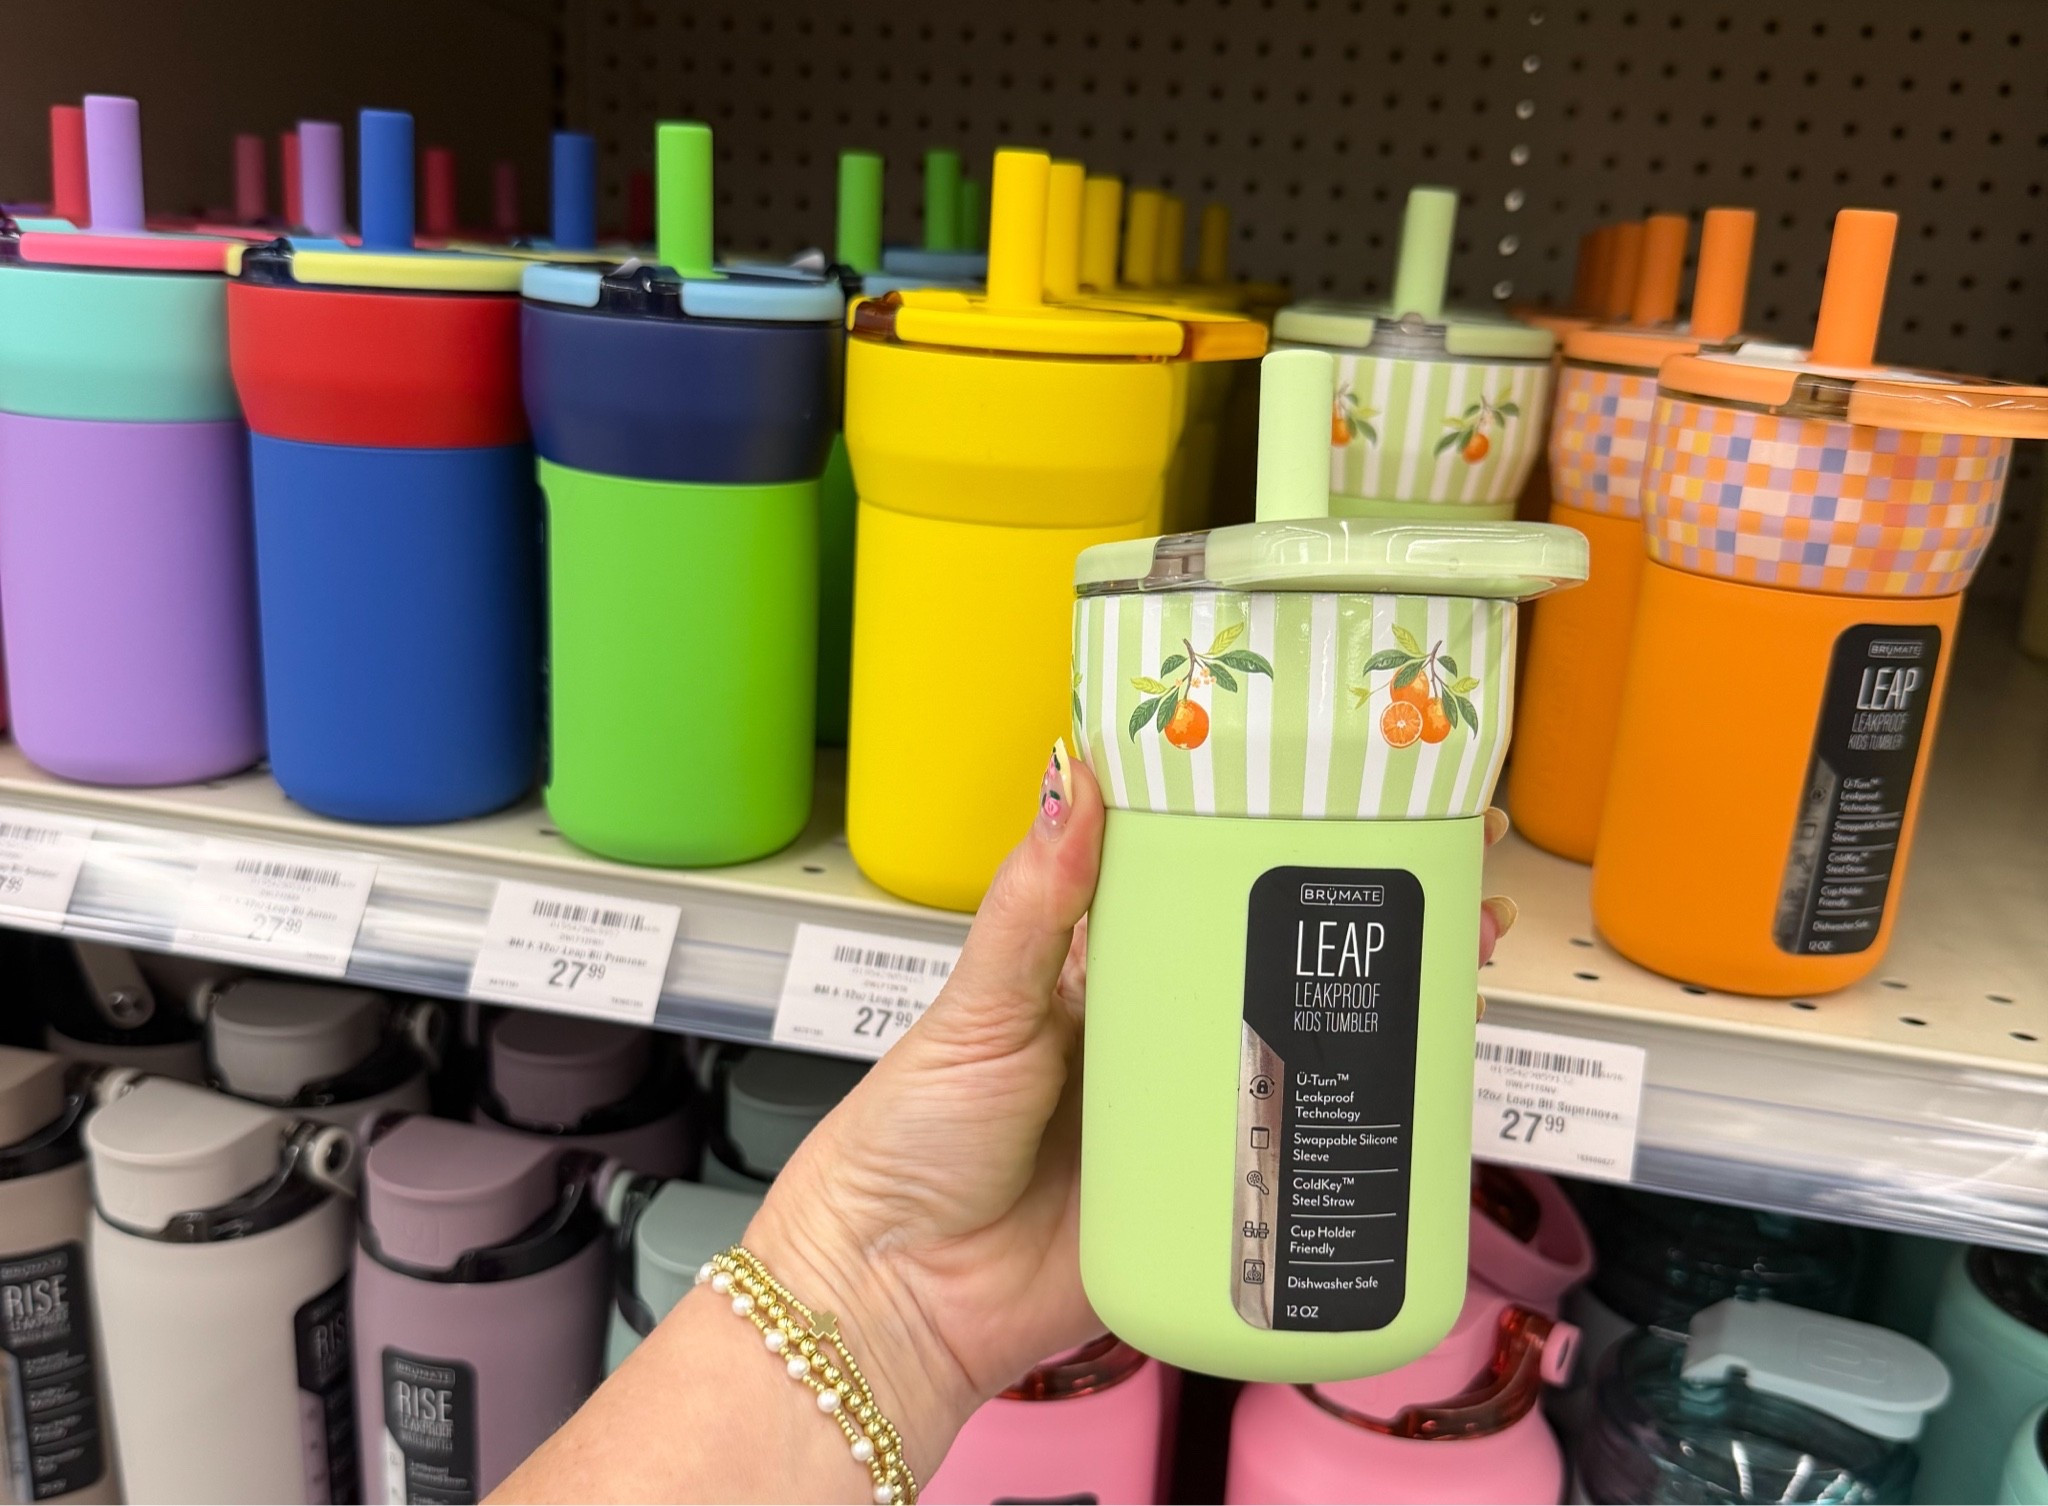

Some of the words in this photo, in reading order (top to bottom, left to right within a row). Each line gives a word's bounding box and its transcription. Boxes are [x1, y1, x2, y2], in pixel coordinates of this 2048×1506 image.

[1857, 666, 1921, 710] LEAP
[1852, 712, 1909, 732] LEAKPROOF
[1848, 734, 1868, 750] KIDS
[1304, 887, 1381, 906] BRÜMATE
[1296, 920, 1385, 977] LEAP
[549, 958, 588, 990] 27
[587, 964, 607, 980] 99
[1295, 981, 1381, 1009] LEAKPROOF
[854, 1006, 893, 1037] 27
[895, 1011, 914, 1029] 99
[1294, 1011, 1321, 1032] KIDS
[1325, 1011, 1379, 1033] TUMBLER
[1295, 1090, 1355, 1105] Leakproof
[1295, 1106, 1361, 1122] Technology
[1499, 1108, 1542, 1143] 27
[1545, 1115, 1565, 1133] 99
[1293, 1132, 1357, 1148] Swappable
[1359, 1133, 1398, 1145] Silicone
[1292, 1149, 1330, 1162] Sleeve
[1292, 1194, 1320, 1207] Steel
[1322, 1194, 1355, 1207] Straw
[1290, 1225, 1316, 1241] Cup
[1317, 1226, 1356, 1238] Holder
[1290, 1241, 1335, 1257] Friendly
[1287, 1276, 1353, 1289] Dishwasher
[1355, 1275, 1379, 1289] Safe
[2, 1274, 67, 1319] RISE
[1286, 1305, 1298, 1317] 12
[1299, 1305, 1319, 1318] OZ
[393, 1380, 453, 1422] RISE
